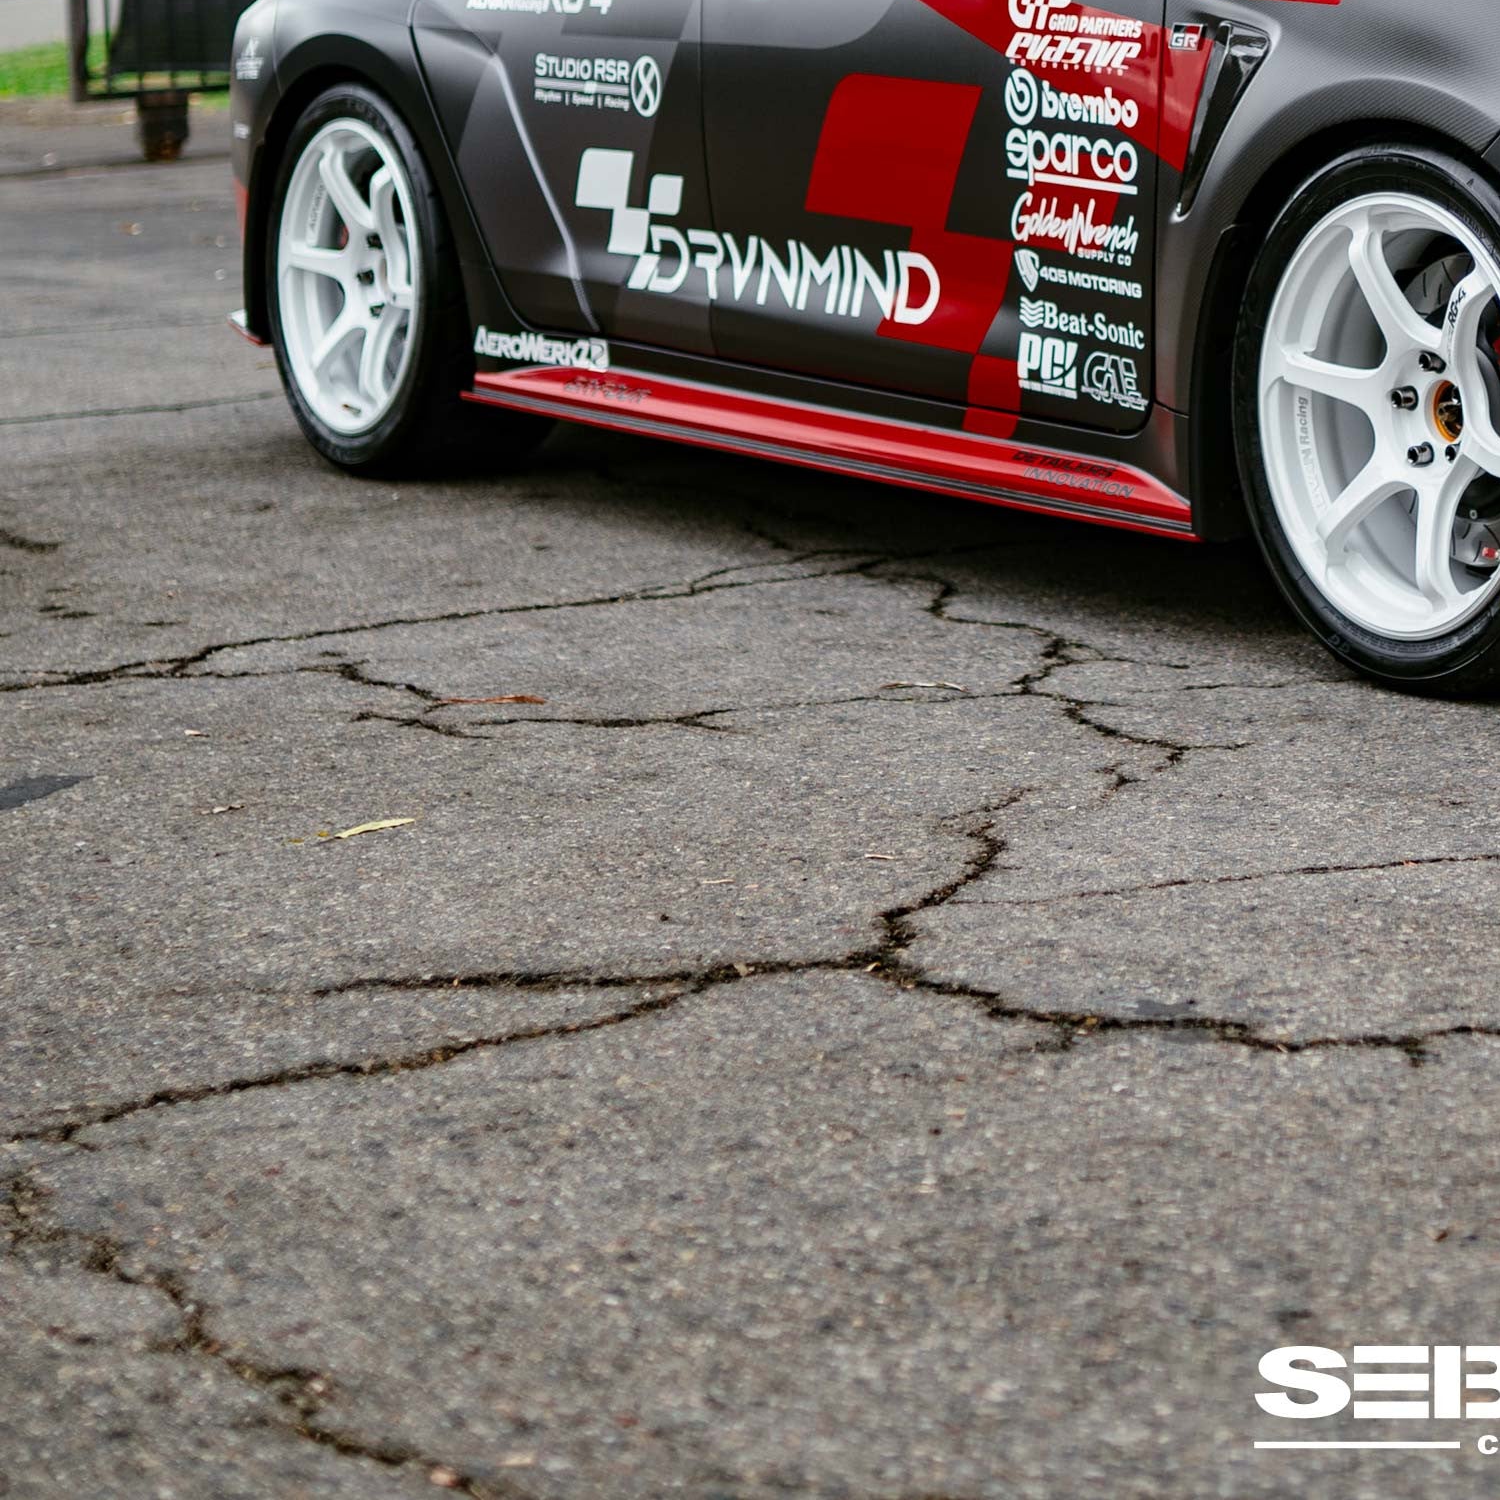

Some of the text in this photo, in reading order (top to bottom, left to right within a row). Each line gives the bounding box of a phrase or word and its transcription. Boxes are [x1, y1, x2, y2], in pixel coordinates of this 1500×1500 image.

[1049, 14, 1143, 39] GRID PARTNERS
[1170, 33, 1199, 48] GR
[535, 53, 631, 84] STUDIO RSR
[1041, 79, 1139, 128] brembo
[1006, 127, 1138, 188] sparco
[1077, 248, 1115, 265] SUPPLY
[648, 225, 941, 325] DRVNMIND
[1040, 265, 1143, 299] 405 MOTORING
[1043, 301, 1145, 350] Beat-Sonic
[1083, 351, 1146, 412] CAE
[1012, 450, 1118, 478] DETAILERS
[1023, 467, 1138, 498] INNOVATION
